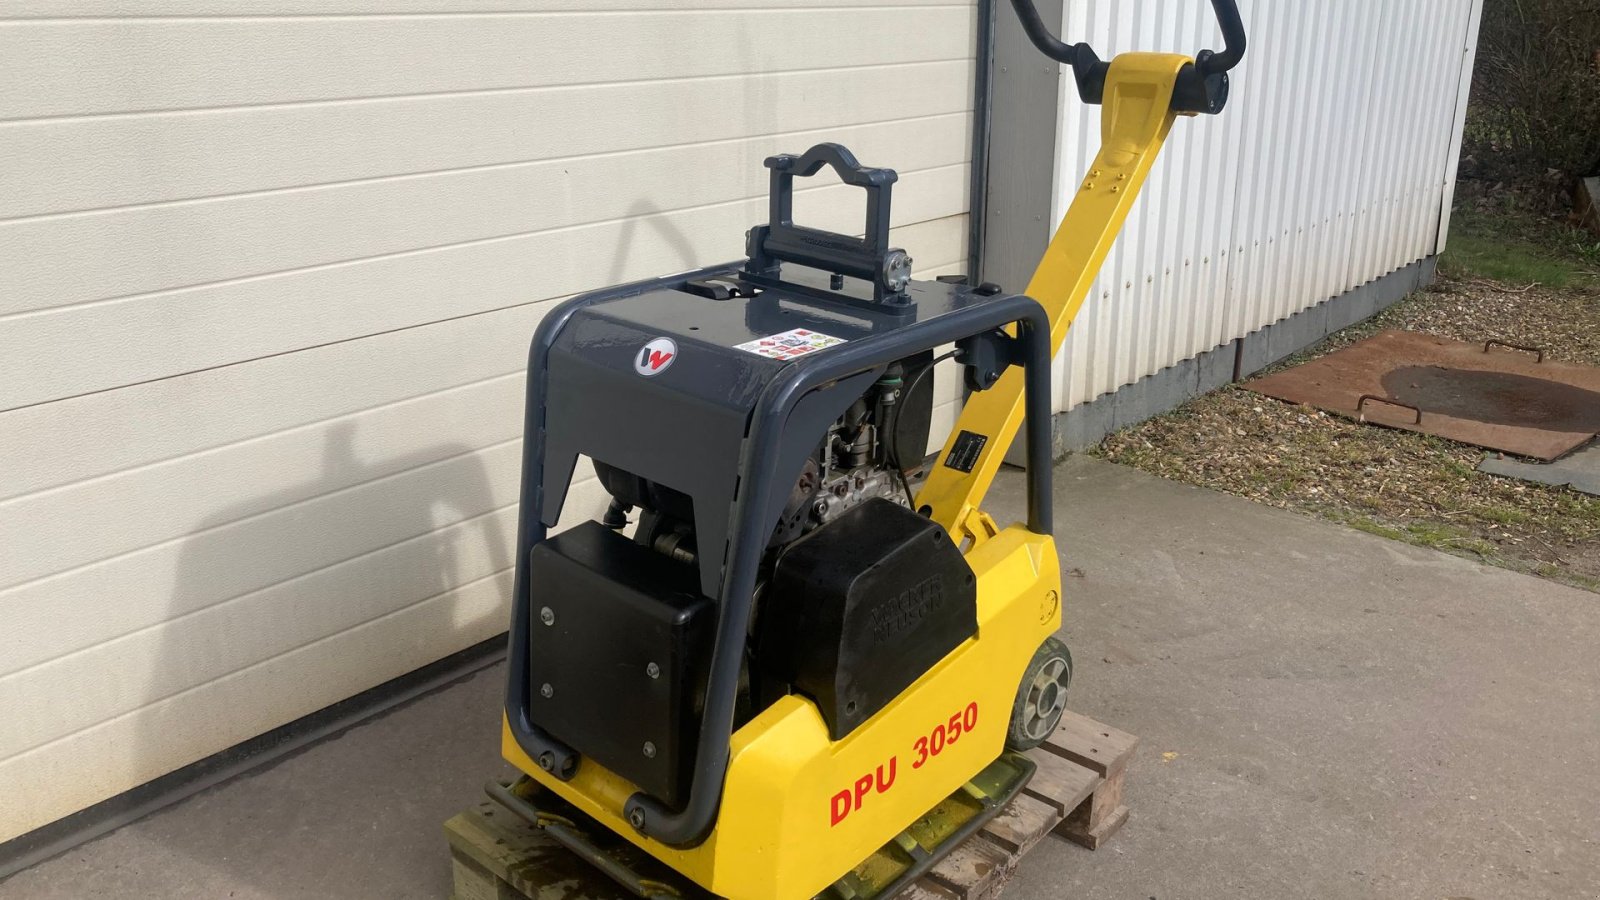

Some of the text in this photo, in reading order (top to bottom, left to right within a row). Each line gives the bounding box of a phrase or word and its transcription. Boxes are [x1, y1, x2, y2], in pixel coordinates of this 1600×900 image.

[871, 573, 944, 625] WACKER
[873, 592, 945, 648] NEUSON
[831, 701, 978, 828] DPU 3050
